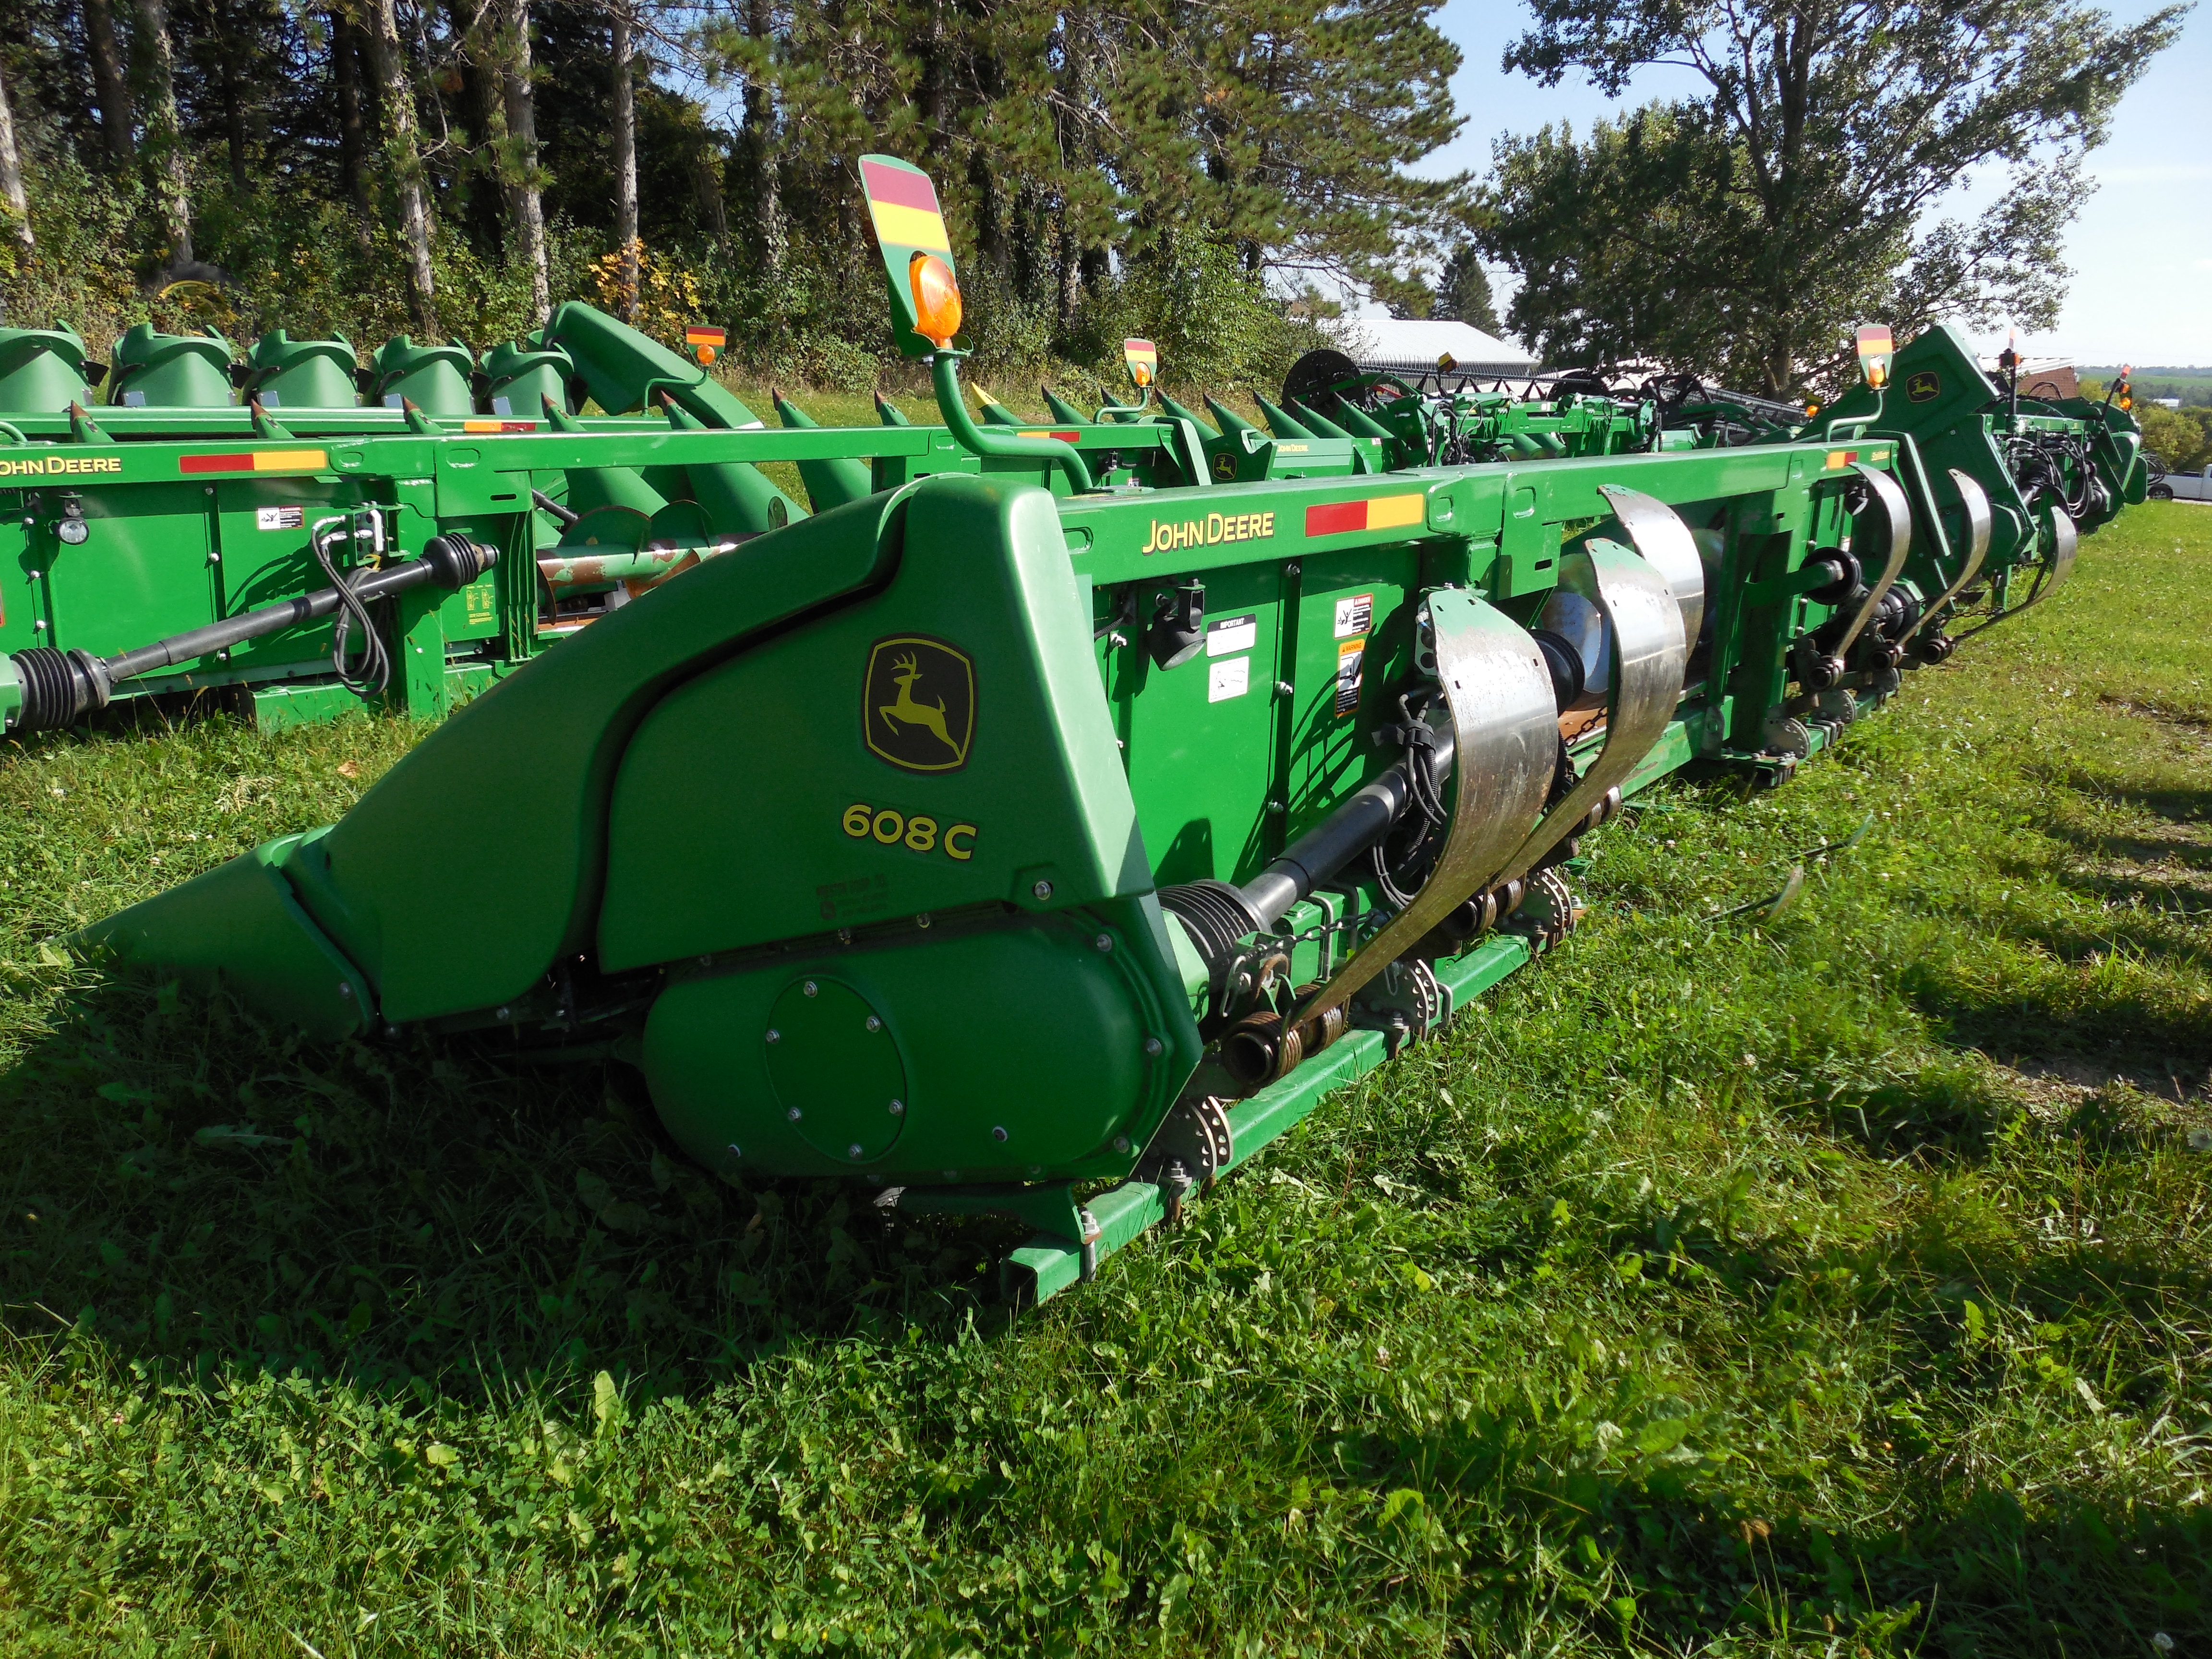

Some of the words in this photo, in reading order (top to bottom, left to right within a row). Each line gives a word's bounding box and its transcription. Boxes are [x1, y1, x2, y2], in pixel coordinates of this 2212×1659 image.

[1277, 444, 1291, 452] JOHN
[1291, 444, 1309, 452] DEERE
[0, 460, 45, 476] OHN
[47, 456, 122, 474] DEERE
[1142, 519, 1205, 556] JOHN
[1206, 512, 1275, 547] DEERE
[1220, 617, 1245, 629] IMPORTANT
[1346, 642, 1362, 651] WARNING
